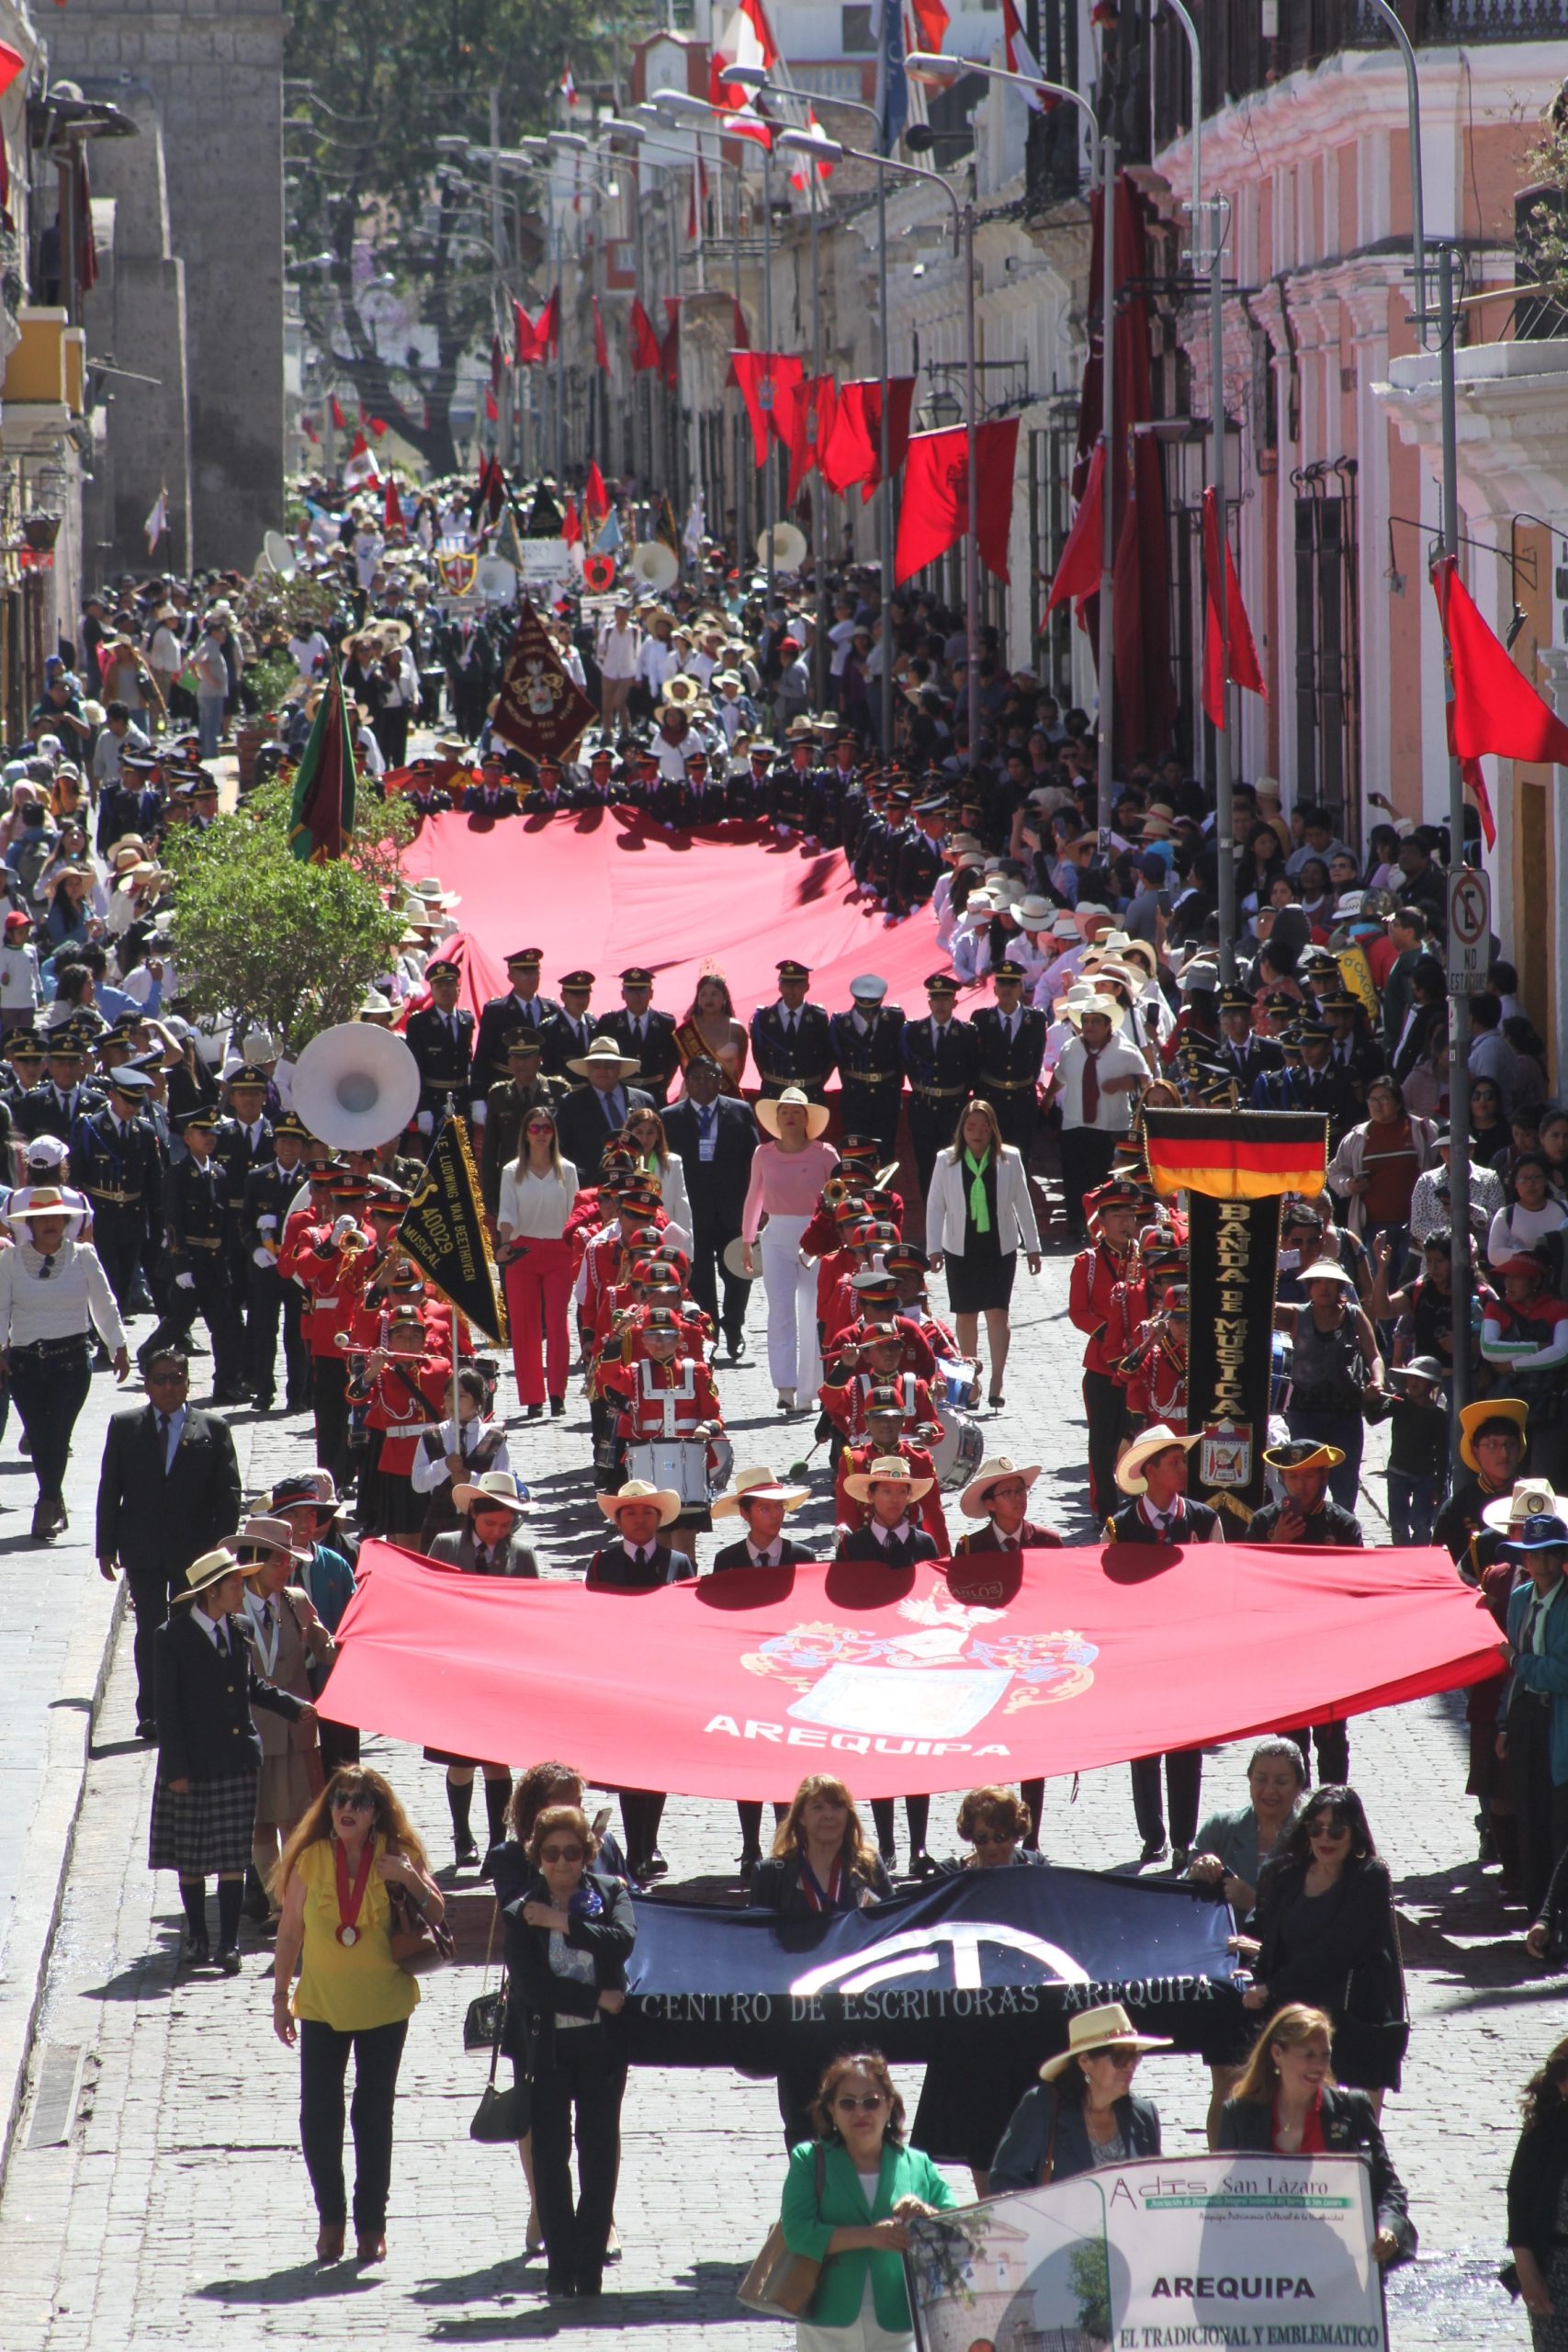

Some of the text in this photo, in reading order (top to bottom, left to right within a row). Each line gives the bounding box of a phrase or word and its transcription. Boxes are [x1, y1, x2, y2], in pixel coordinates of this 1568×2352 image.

[1464, 949, 1477, 970] NO
[440, 1155, 459, 1198] LUDWING
[422, 1207, 454, 1254] 40029
[450, 1202, 464, 1222] VAN
[402, 1224, 444, 1270] MUSICAL
[455, 1223, 476, 1283] BEETHOVEN
[1210, 1203, 1251, 1415] BANDA DE MUSICA
[704, 1714, 1011, 1757] AREQUIPA
[640, 1973, 1214, 2023] CENTRO DE ESCRITORAS AREQUIPA
[1223, 2177, 1258, 2195] San
[1268, 2177, 1328, 2195] Lázaro
[1151, 2278, 1316, 2301] AREQUIPA
[1121, 2324, 1378, 2348] EL TRADICIONAL Y EMBLEMATICO
